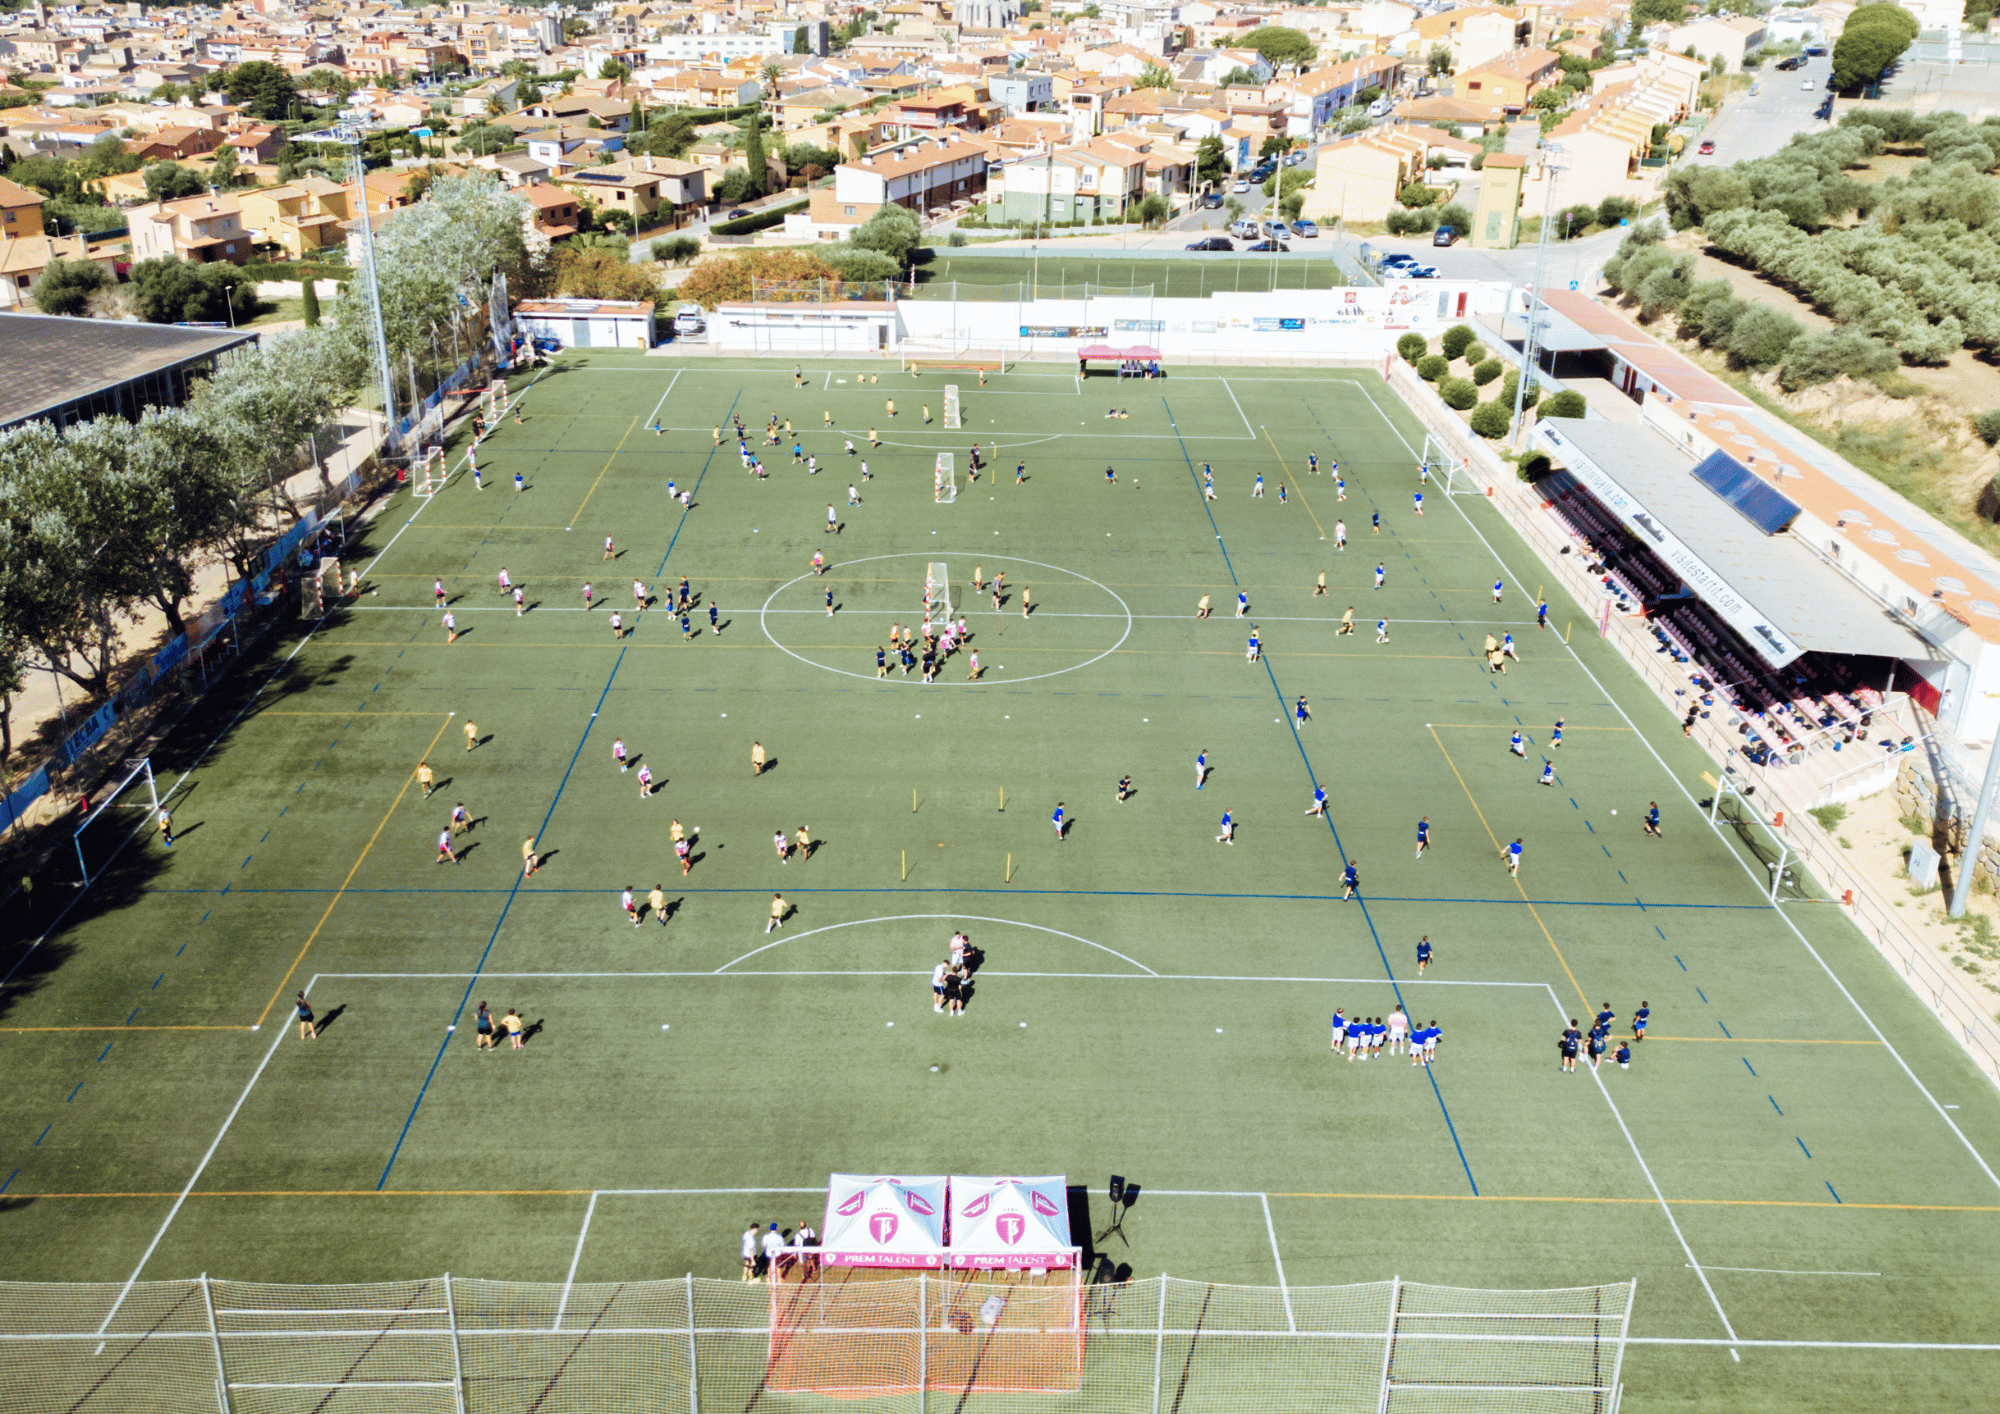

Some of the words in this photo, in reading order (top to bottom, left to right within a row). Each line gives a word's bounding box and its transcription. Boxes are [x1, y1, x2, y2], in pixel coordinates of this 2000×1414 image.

[844, 1254, 876, 1263] PREM
[878, 1255, 916, 1265] TALENT
[974, 1256, 1005, 1265] PREM
[1008, 1256, 1047, 1265] TALENT
